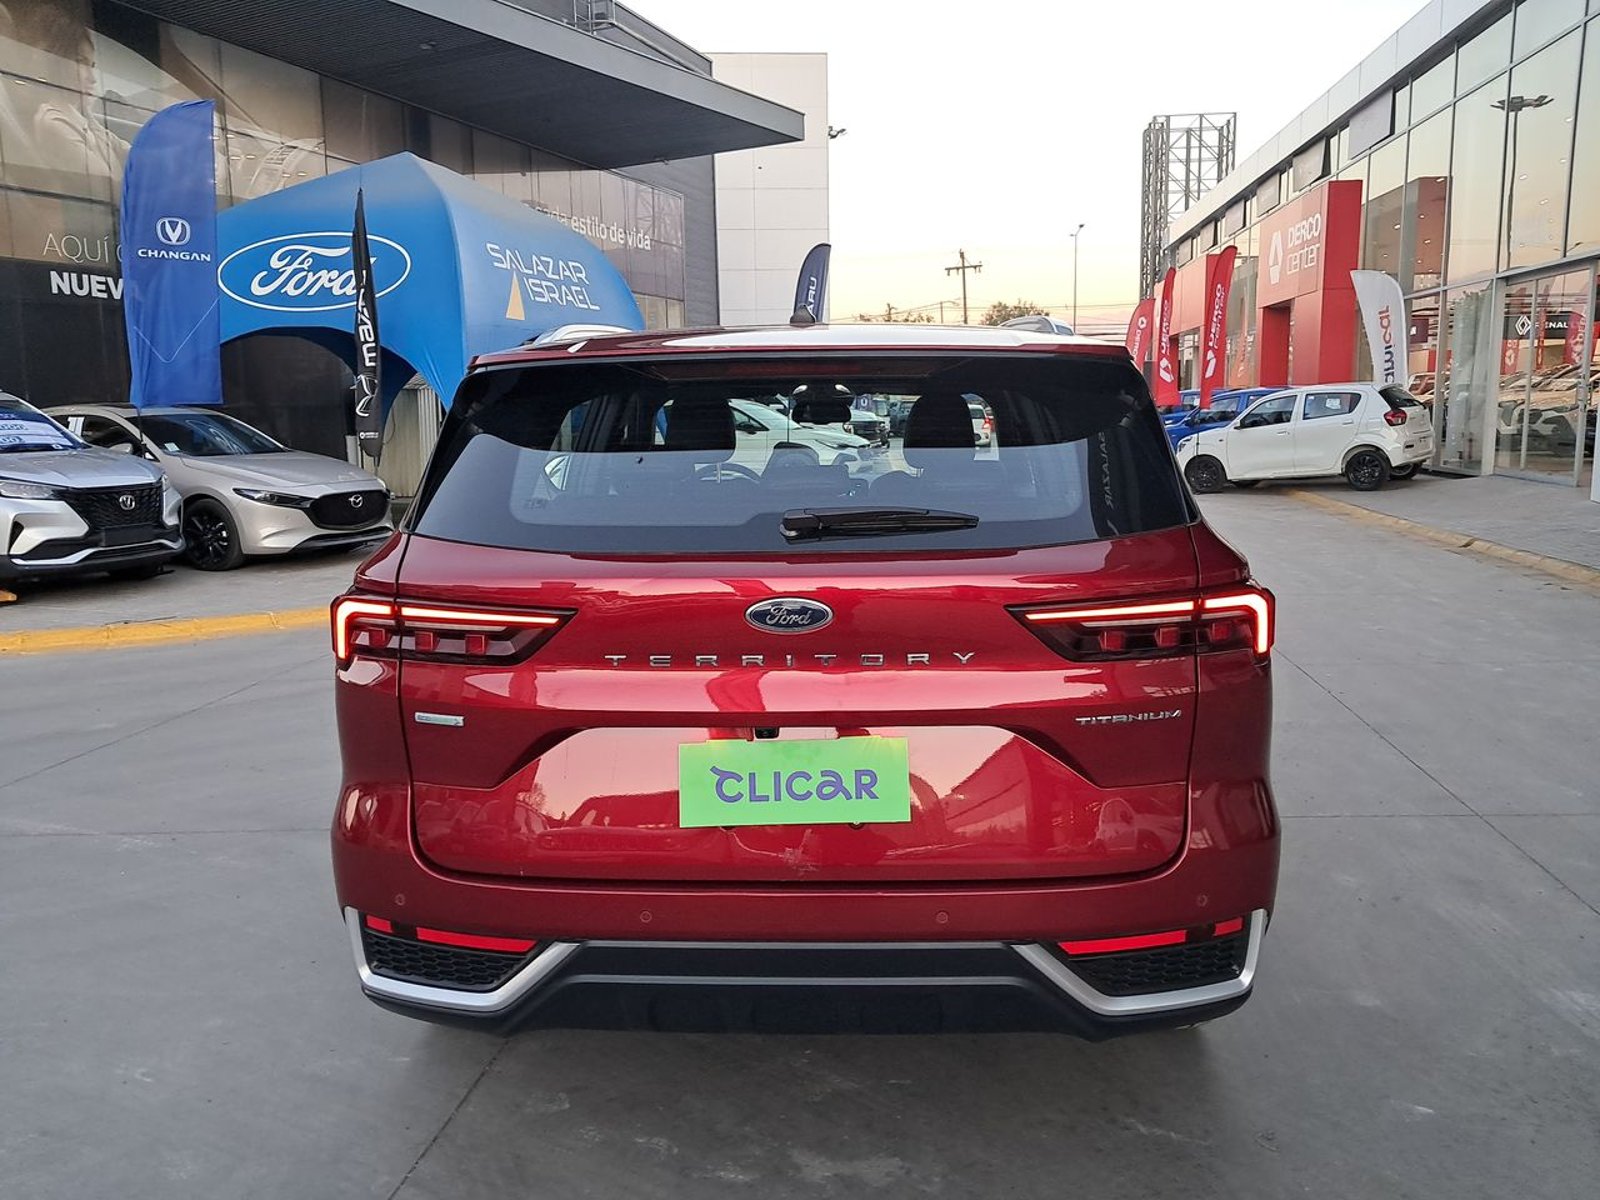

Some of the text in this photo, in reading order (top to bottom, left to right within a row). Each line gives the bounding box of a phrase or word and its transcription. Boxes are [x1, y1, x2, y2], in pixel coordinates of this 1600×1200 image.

[571, 215, 607, 239] estilo
[609, 221, 625, 244] de
[625, 227, 651, 250] vida
[1287, 213, 1321, 250] DERCO
[42, 233, 109, 264] AQUÍ
[137, 248, 211, 262] CHANGAN
[486, 243, 590, 285] SALAZAR
[49, 270, 124, 299] NUEV
[523, 277, 600, 310] ISRAEL
[765, 603, 813, 626] Ford
[604, 651, 975, 667] TERRITORY
[1075, 709, 1182, 725] TITANIUM
